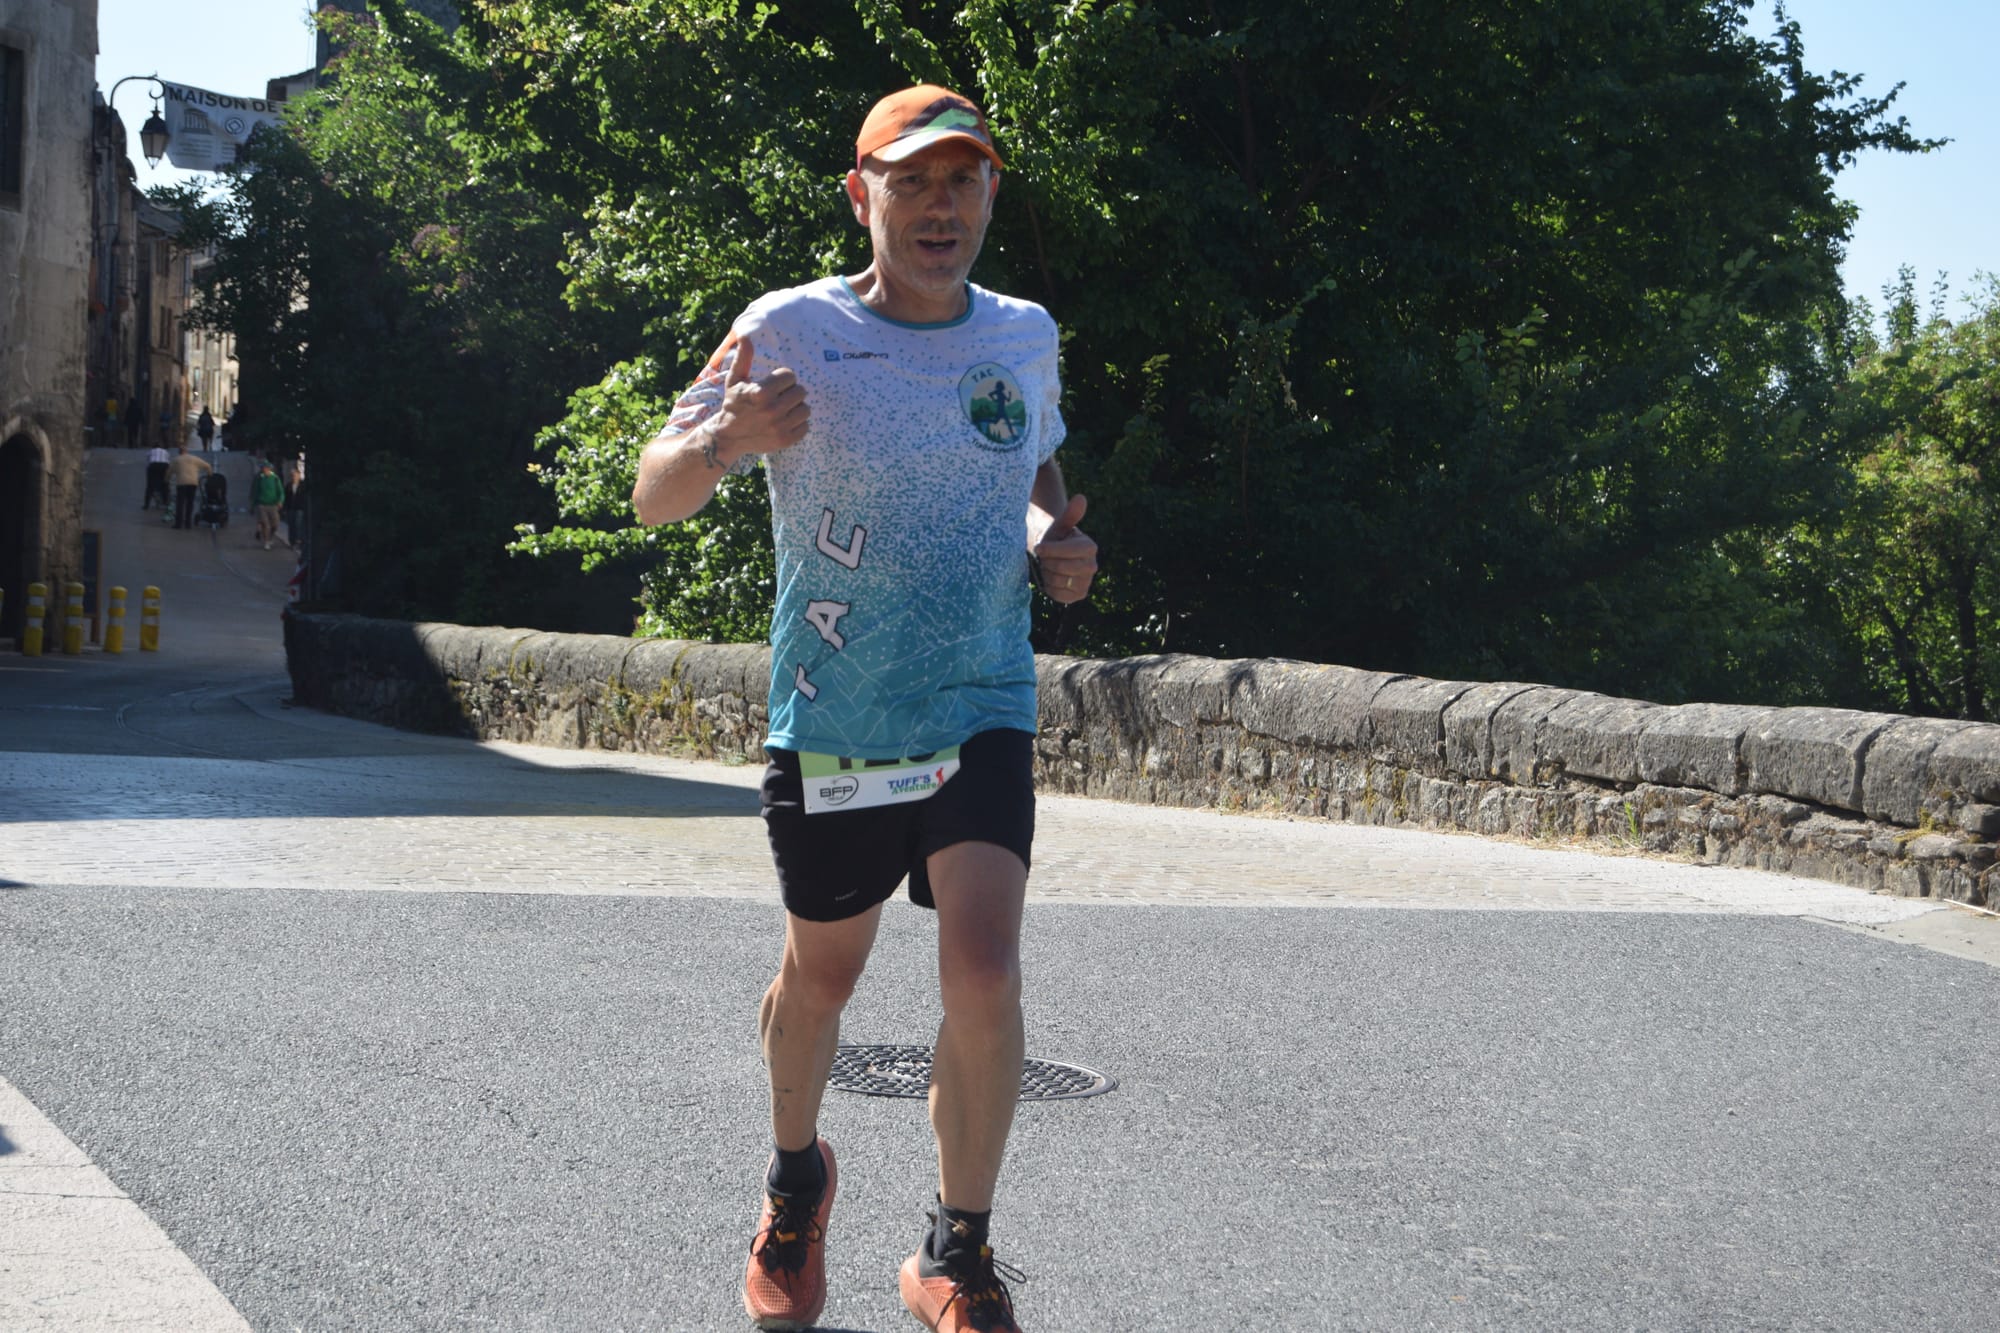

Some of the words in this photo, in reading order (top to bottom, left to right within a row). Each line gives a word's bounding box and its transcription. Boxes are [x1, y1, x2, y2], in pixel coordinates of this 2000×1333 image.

[167, 86, 246, 110] MAISON
[252, 101, 278, 113] DE
[887, 774, 931, 789] TUFF'S
[819, 785, 853, 798] BFP
